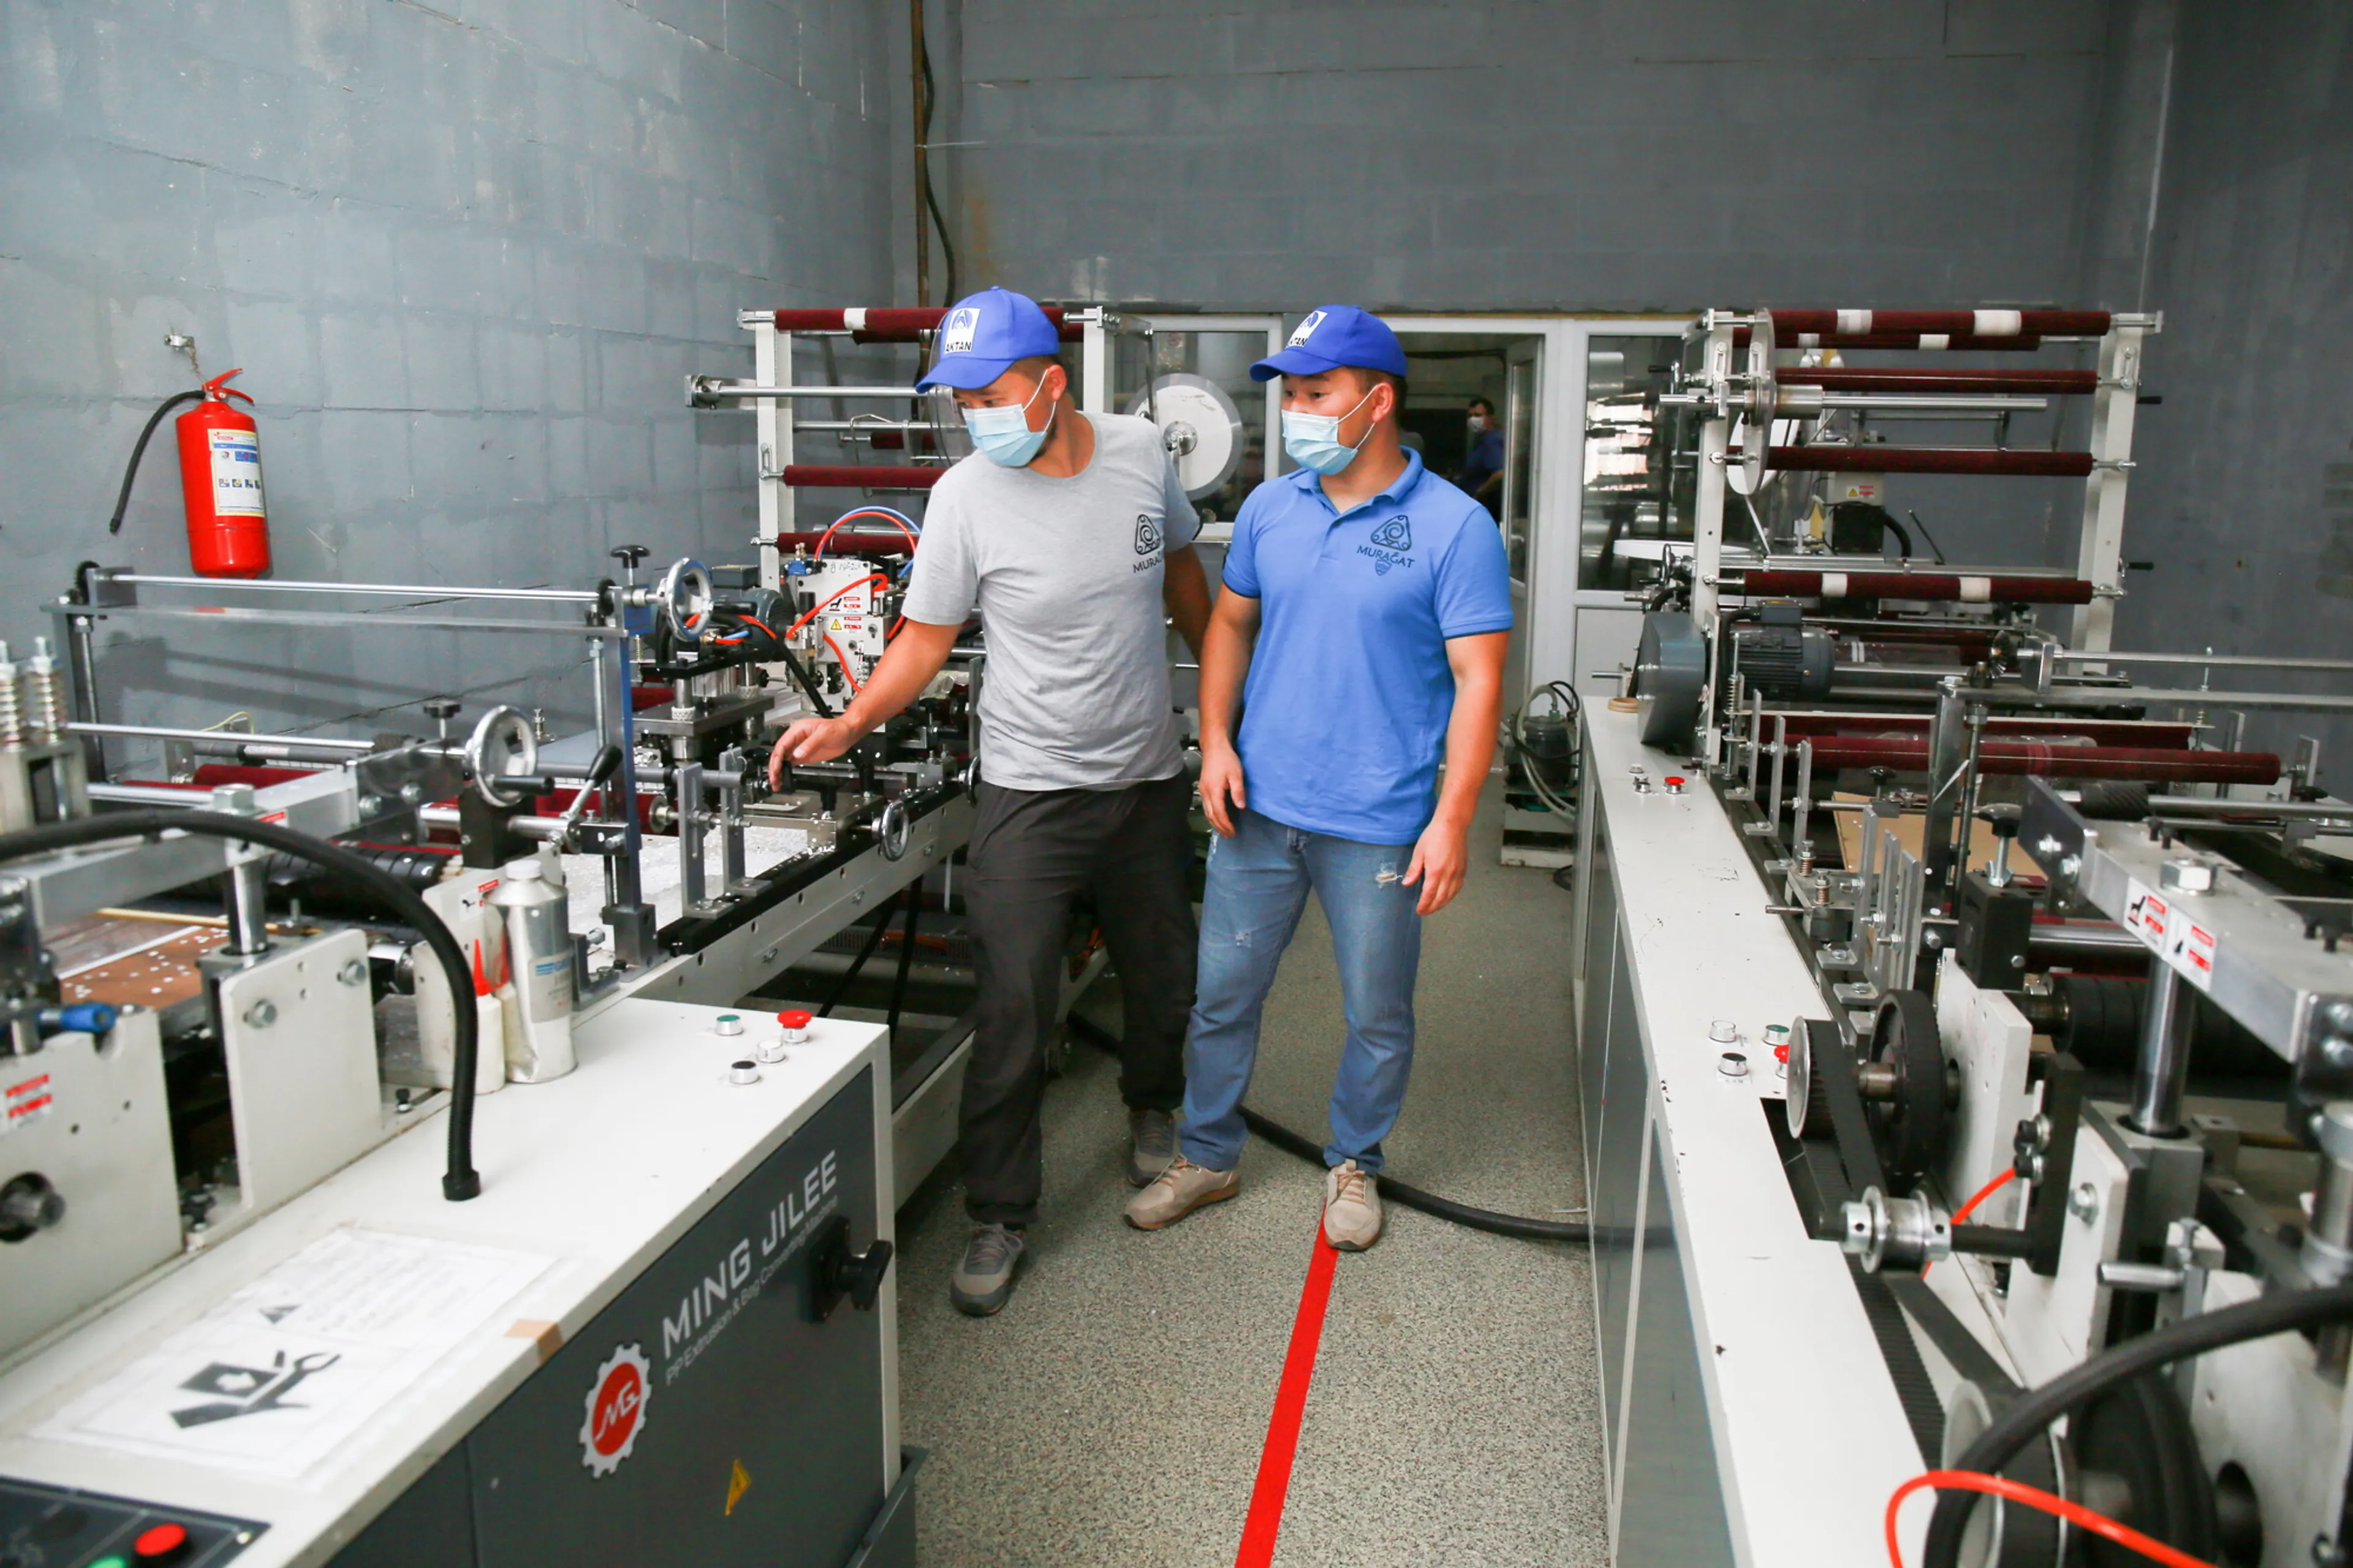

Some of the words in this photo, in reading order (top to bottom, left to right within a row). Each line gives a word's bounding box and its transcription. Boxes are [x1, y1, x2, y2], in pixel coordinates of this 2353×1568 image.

[662, 1238, 751, 1360] MING
[762, 1149, 836, 1257] JILEE
[683, 1309, 732, 1368] Extrusion
[732, 1297, 741, 1316] &
[741, 1279, 760, 1306] Bag
